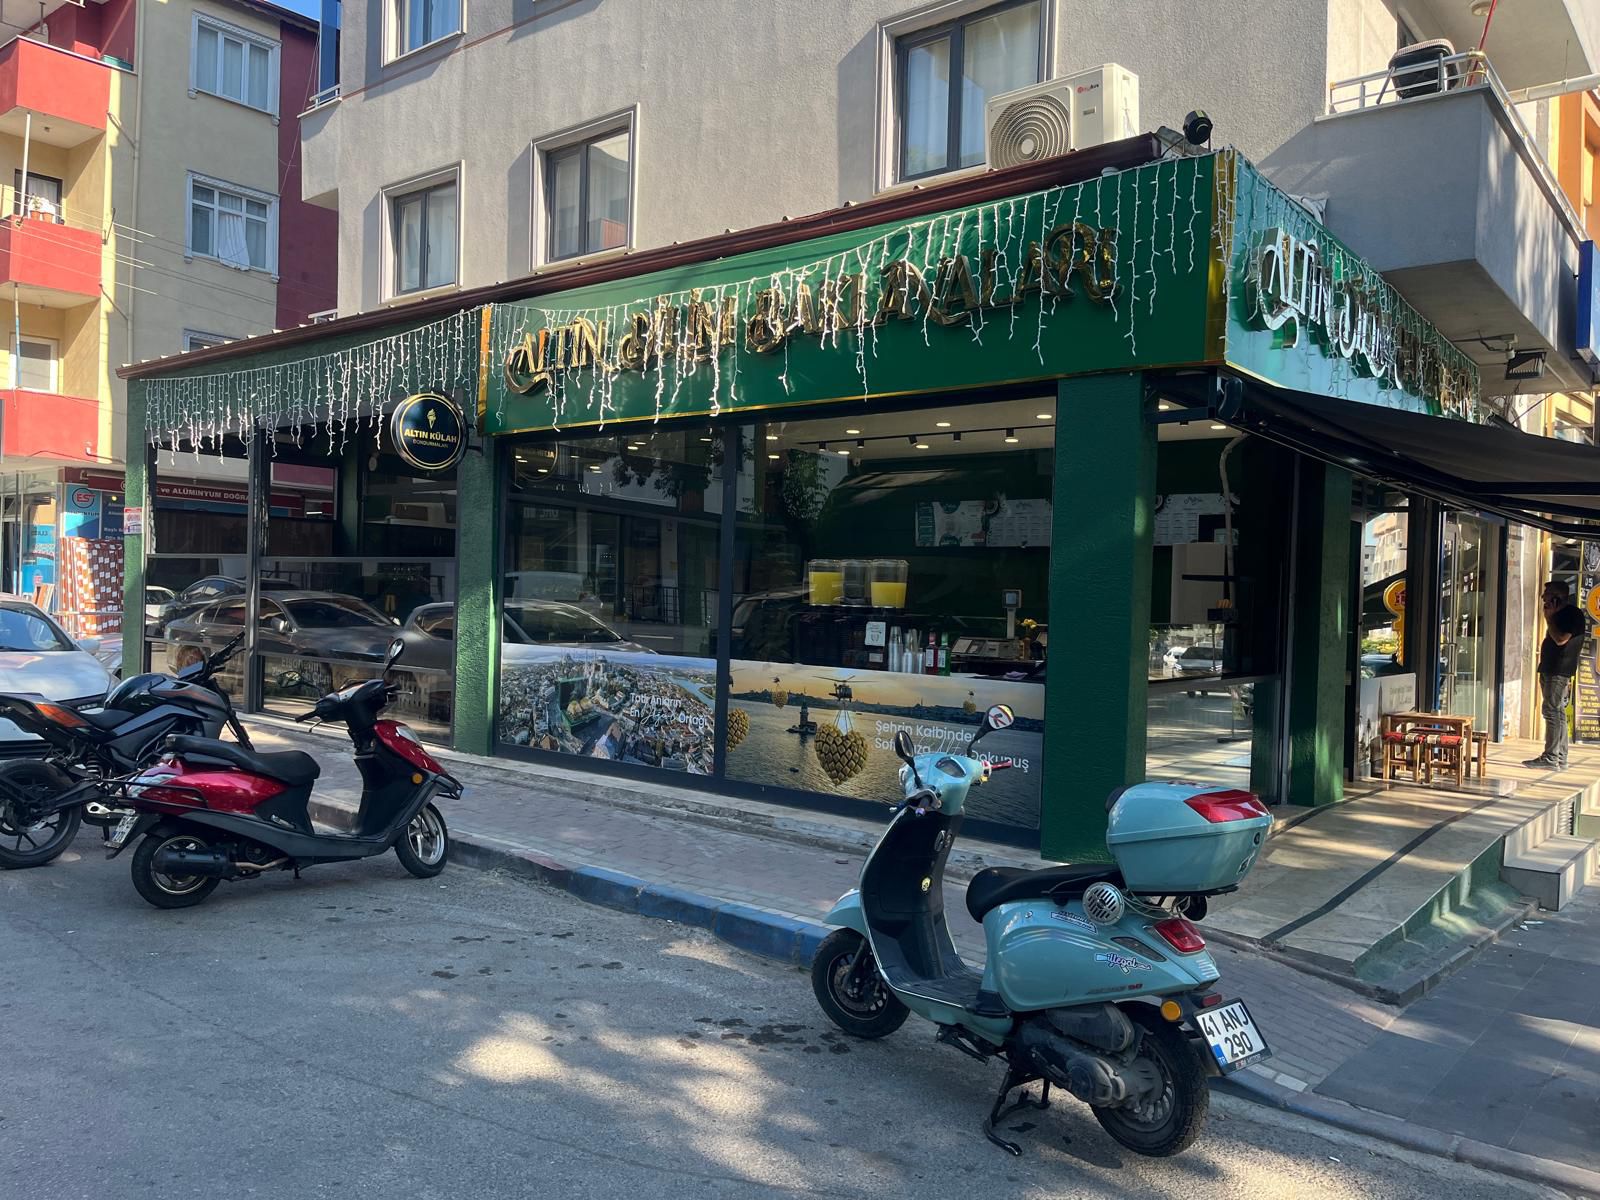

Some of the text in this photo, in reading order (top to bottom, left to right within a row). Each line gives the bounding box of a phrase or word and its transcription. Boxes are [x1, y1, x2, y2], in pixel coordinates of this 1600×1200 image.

[404, 429, 457, 443] ALTIN KÜLAH
[630, 707, 640, 718] En
[875, 719, 913, 736] Şehrin
[875, 737, 931, 754] Sofıza
[1202, 1004, 1249, 1038] 41 ANJ
[1224, 1030, 1254, 1058] 290
